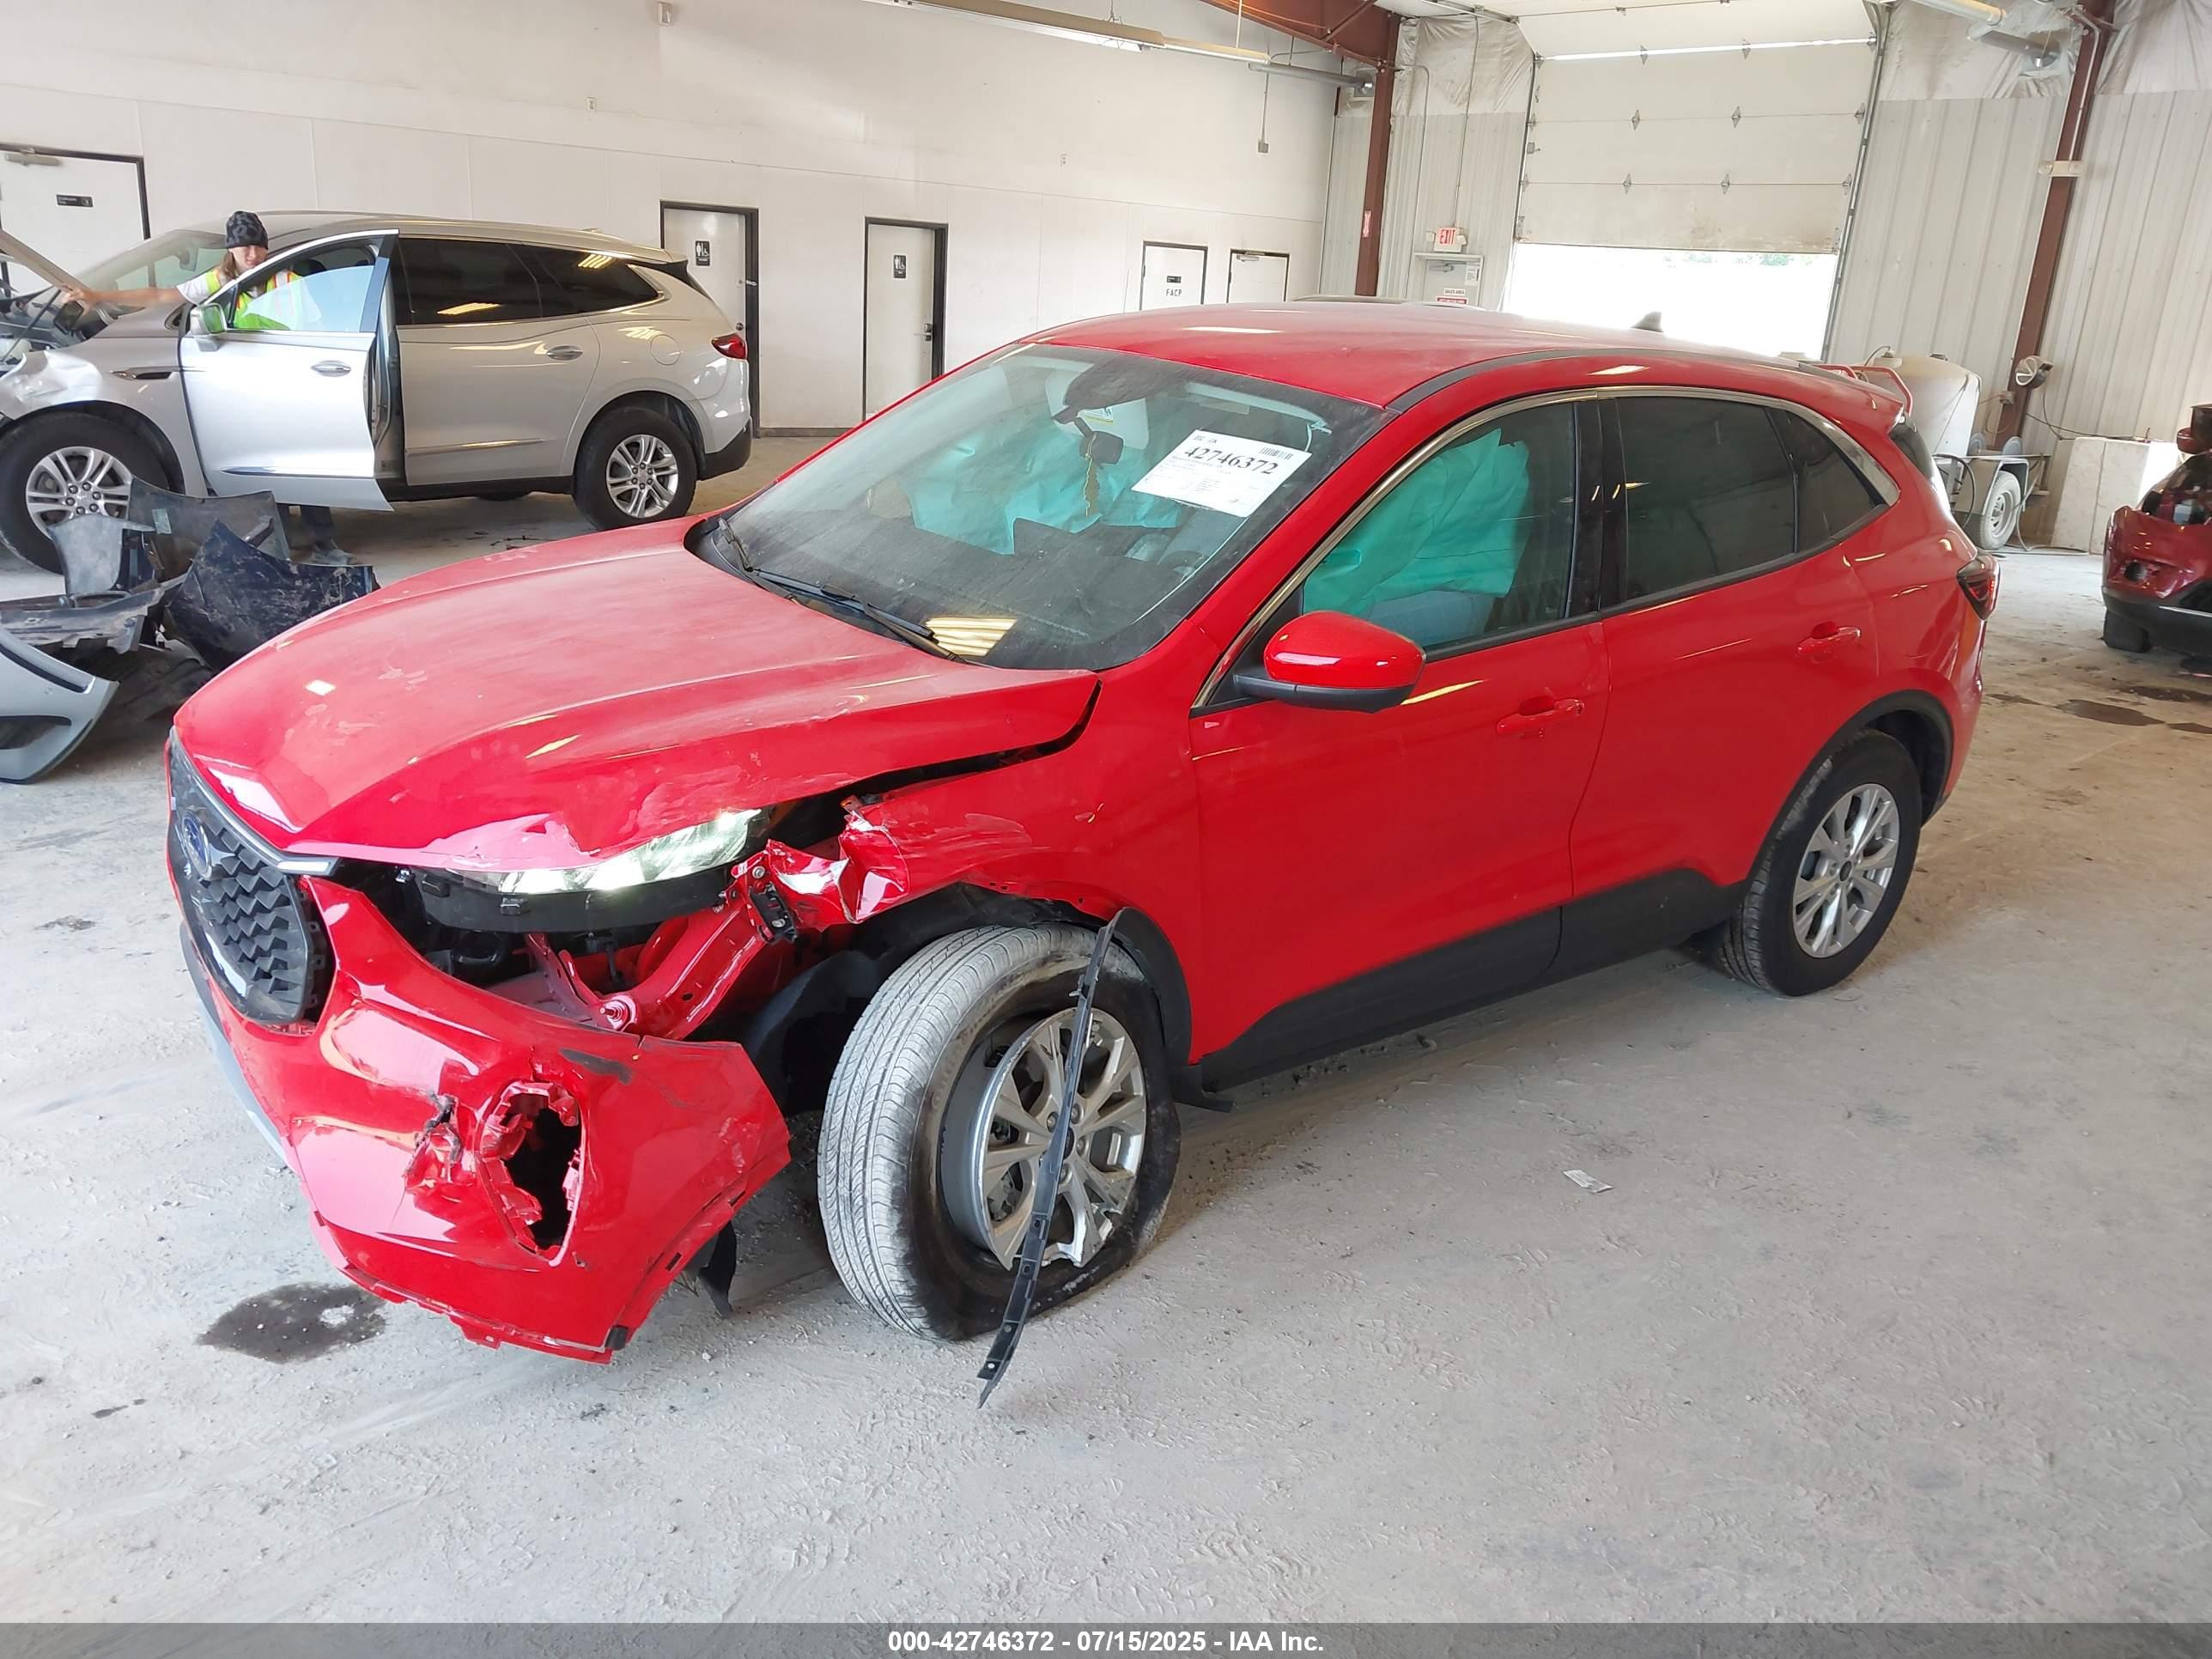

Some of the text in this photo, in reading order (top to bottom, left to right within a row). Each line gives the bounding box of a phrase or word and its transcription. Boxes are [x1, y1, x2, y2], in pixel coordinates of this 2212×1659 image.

[1439, 228, 1455, 245] EXIT
[1165, 288, 1182, 297] FACP
[1184, 447, 1279, 475] 42746372
